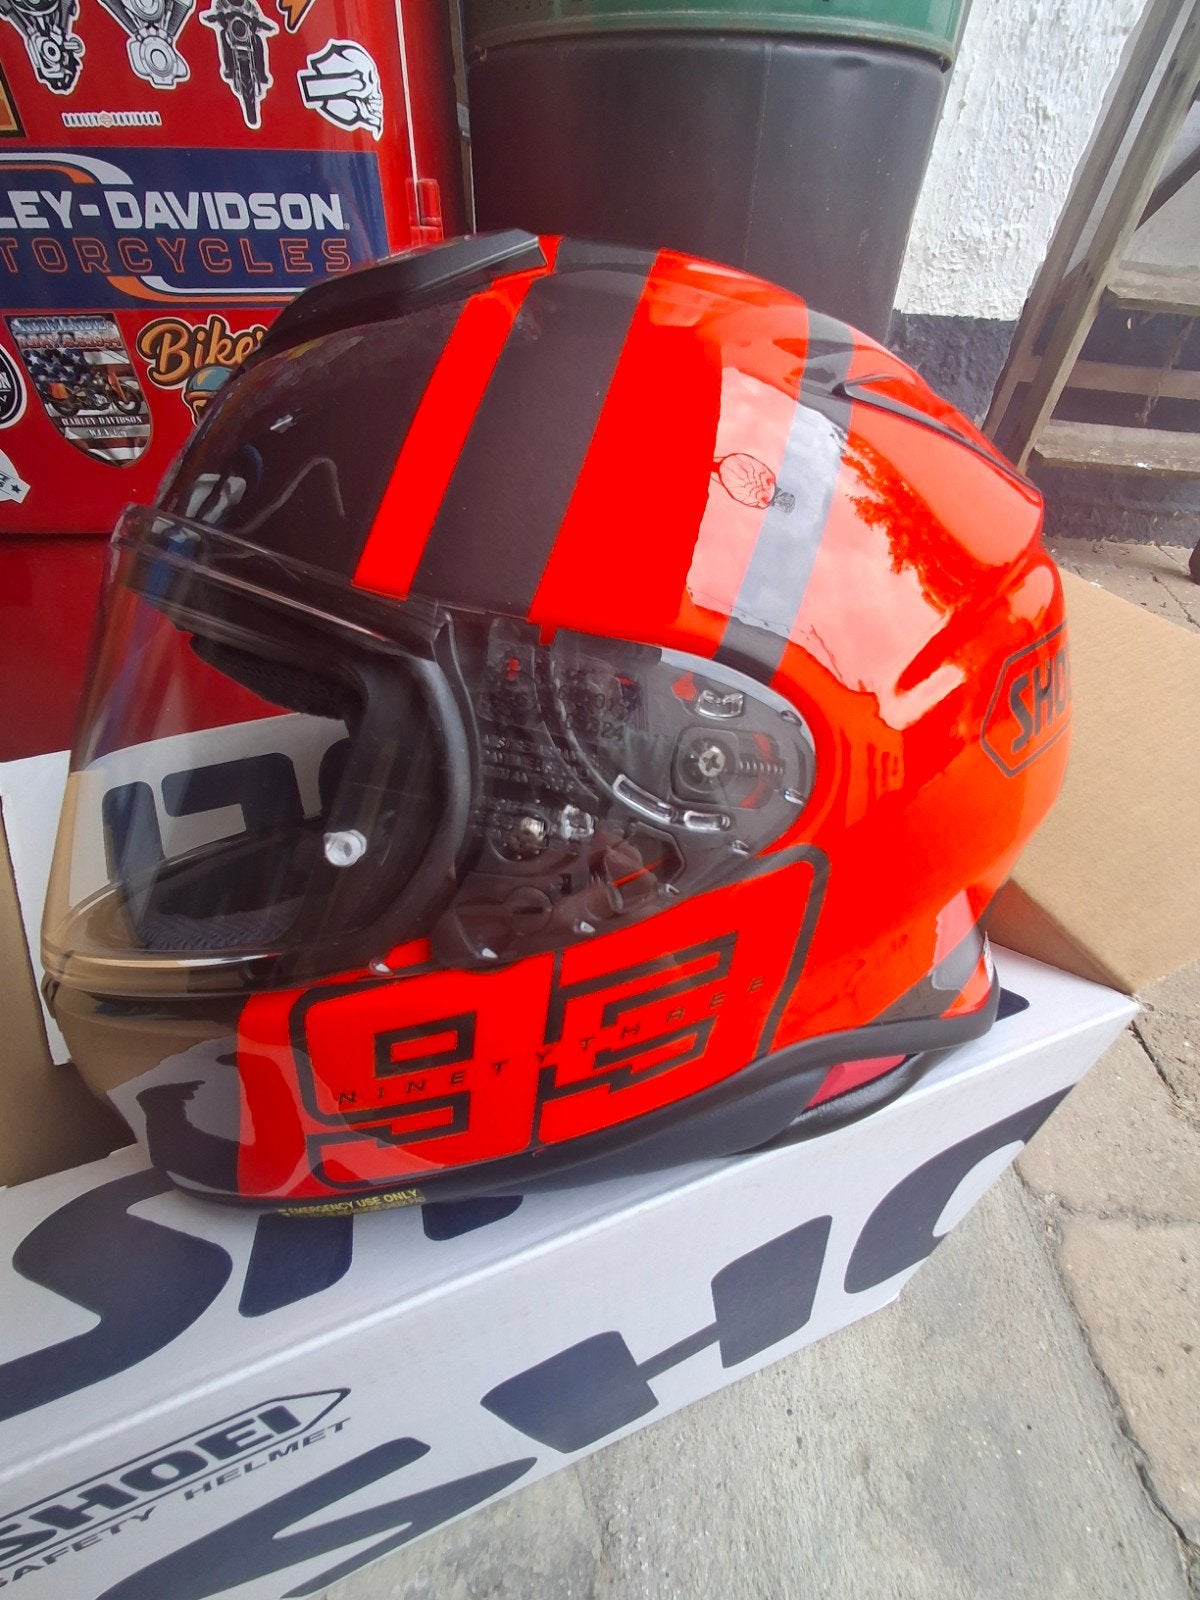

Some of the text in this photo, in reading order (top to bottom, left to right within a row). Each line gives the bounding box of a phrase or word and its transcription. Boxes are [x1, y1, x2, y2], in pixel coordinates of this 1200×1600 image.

[61, 415, 142, 426] HARLEY DAVIDSON
[337, 976, 764, 1105] NINETY THREE
[288, 1200, 354, 1216] EMERGENCY
[356, 1196, 382, 1208] USE
[383, 1188, 418, 1202] ONLY
[184, 1416, 352, 1501] HELMET
